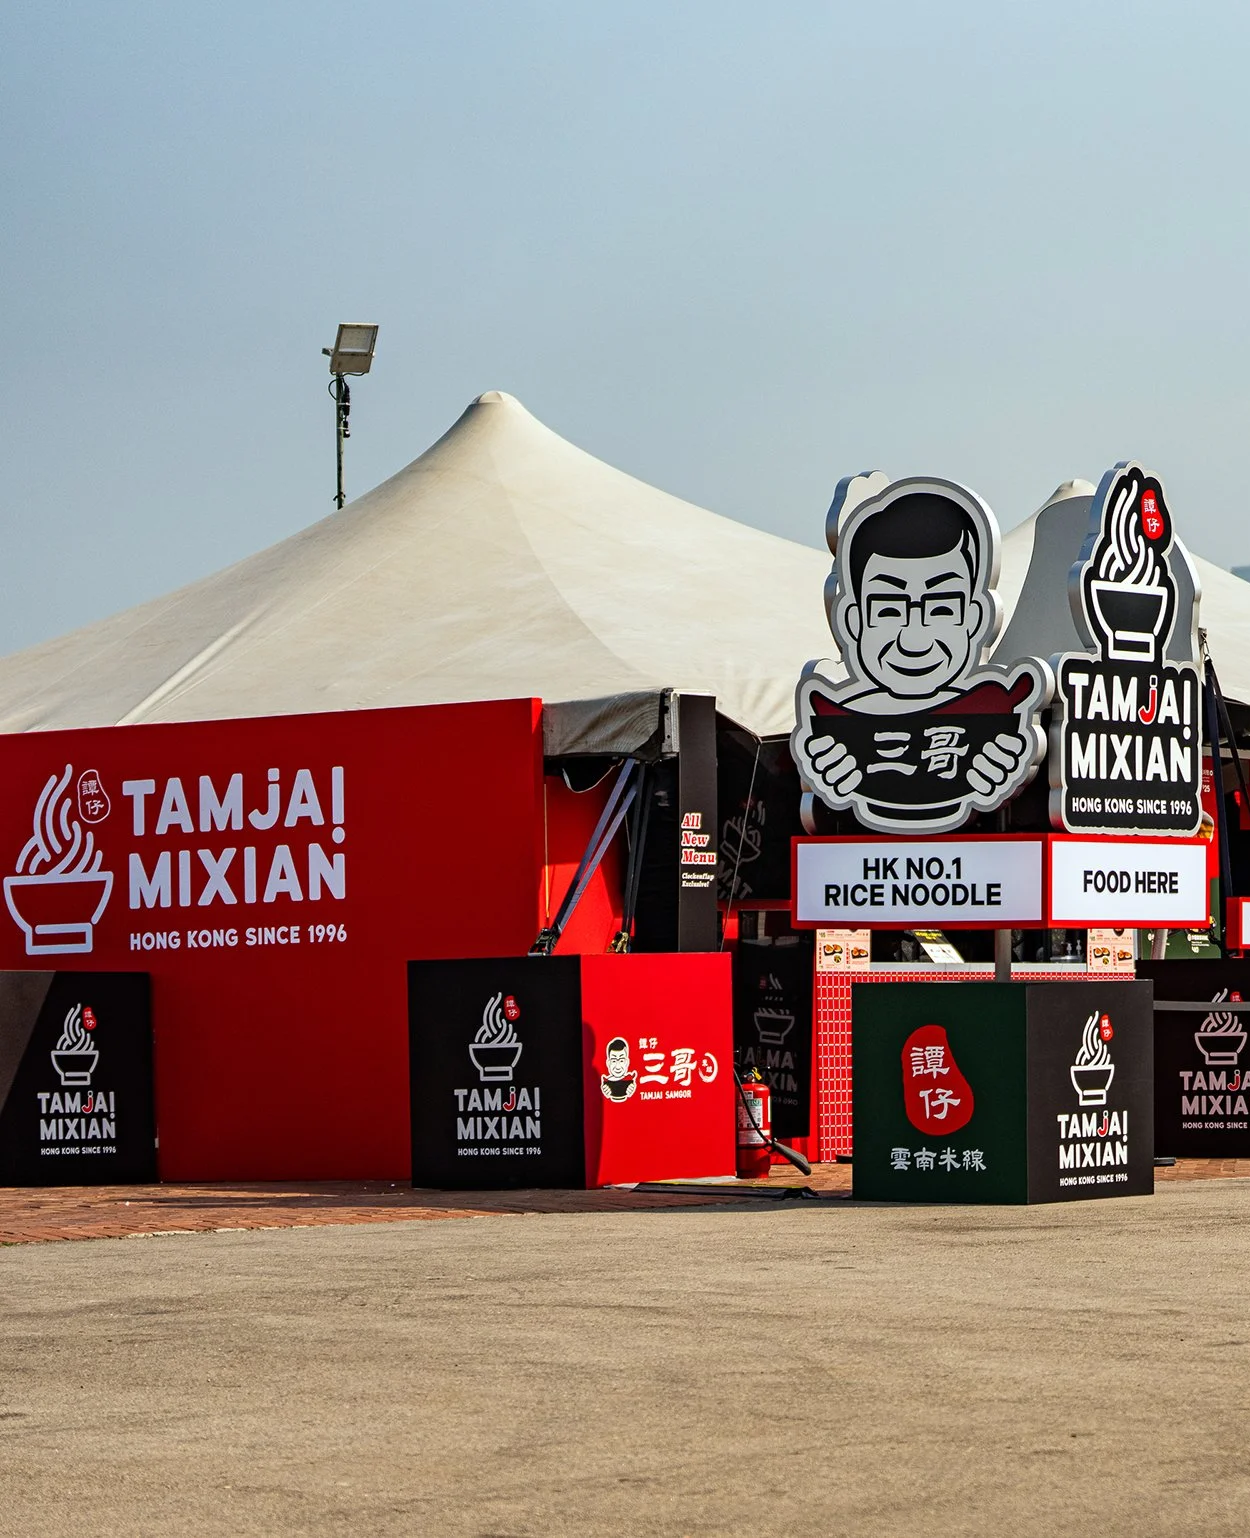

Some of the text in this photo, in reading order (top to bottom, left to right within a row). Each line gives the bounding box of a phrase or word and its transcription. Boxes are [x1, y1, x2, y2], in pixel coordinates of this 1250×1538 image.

[1143, 497, 1160, 534] 譚仔
[867, 726, 970, 780] 三哥
[1071, 732, 1192, 783] MIXIAN
[82, 780, 104, 815] 譚仔
[1072, 797, 1192, 816] HONG KONG SINCE 1996
[681, 814, 701, 828] All
[681, 832, 709, 846] New
[681, 850, 717, 864] Menu
[863, 857, 962, 881] HK NO.1
[129, 843, 345, 909] MIXIAN
[1083, 870, 1178, 894] FOOD HERE
[825, 883, 1002, 907] RICE NOODLE
[130, 924, 347, 950] HONG KONG SINCE 1996
[640, 1048, 698, 1086] 三哥
[640, 1090, 692, 1100] TAMJAI SAMGOR
[910, 1046, 961, 1120] 譚仔
[40, 1118, 116, 1140] MIXIAN
[457, 1116, 541, 1140] MIXIAN
[458, 1147, 542, 1156] HONG KONG SINCE 1996
[890, 1147, 987, 1172] 雲南米線
[1059, 1140, 1128, 1169] MIXIAN
[1060, 1173, 1128, 1186] HONG KONG SINCE 1996
